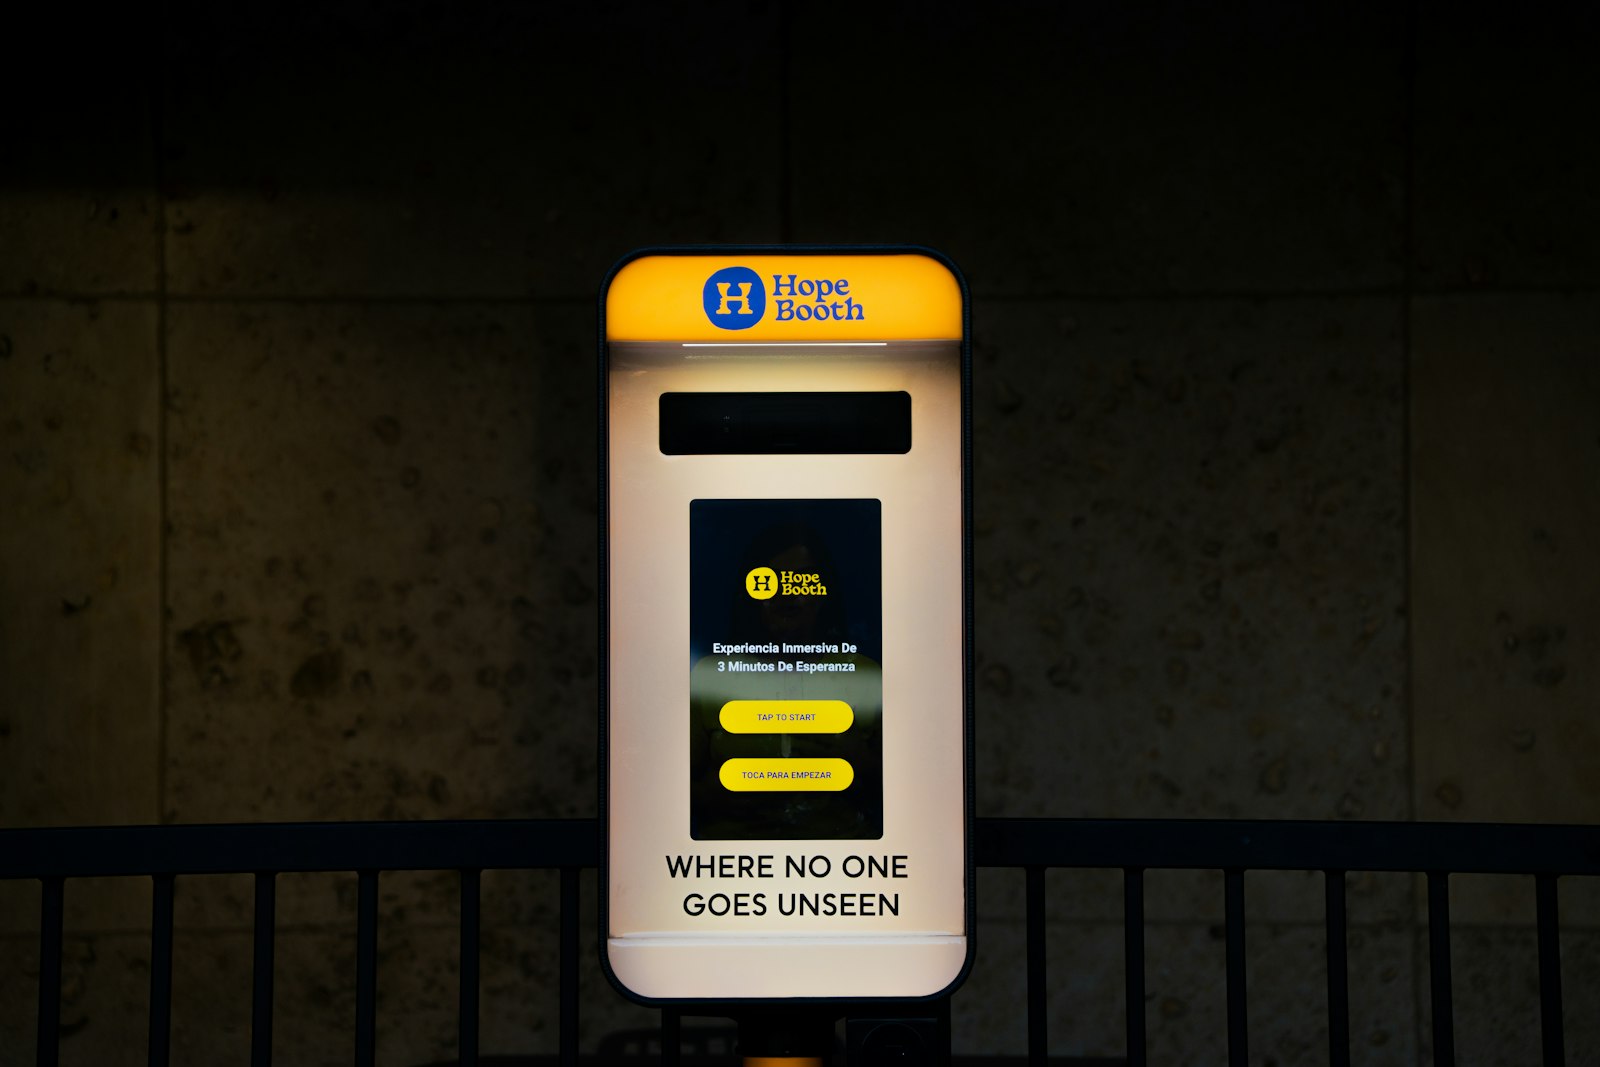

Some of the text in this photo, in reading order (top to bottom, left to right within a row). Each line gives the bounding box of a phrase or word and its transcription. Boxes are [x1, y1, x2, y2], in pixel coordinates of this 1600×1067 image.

[773, 274, 850, 302] Hope
[715, 282, 753, 315] H
[776, 297, 865, 321] Booth
[753, 575, 771, 592] H
[780, 570, 820, 586] Hope
[782, 582, 828, 596] Booth
[713, 642, 857, 656] Experiencia Inmersiva De
[717, 661, 856, 675] 3 Minutos De Esperanza
[757, 713, 816, 721] TAP TO START
[742, 771, 832, 779] TOCA PARA EMPEZAR
[666, 855, 909, 879] WHERE NO ONE
[682, 893, 899, 917] GOES UNSEEN
